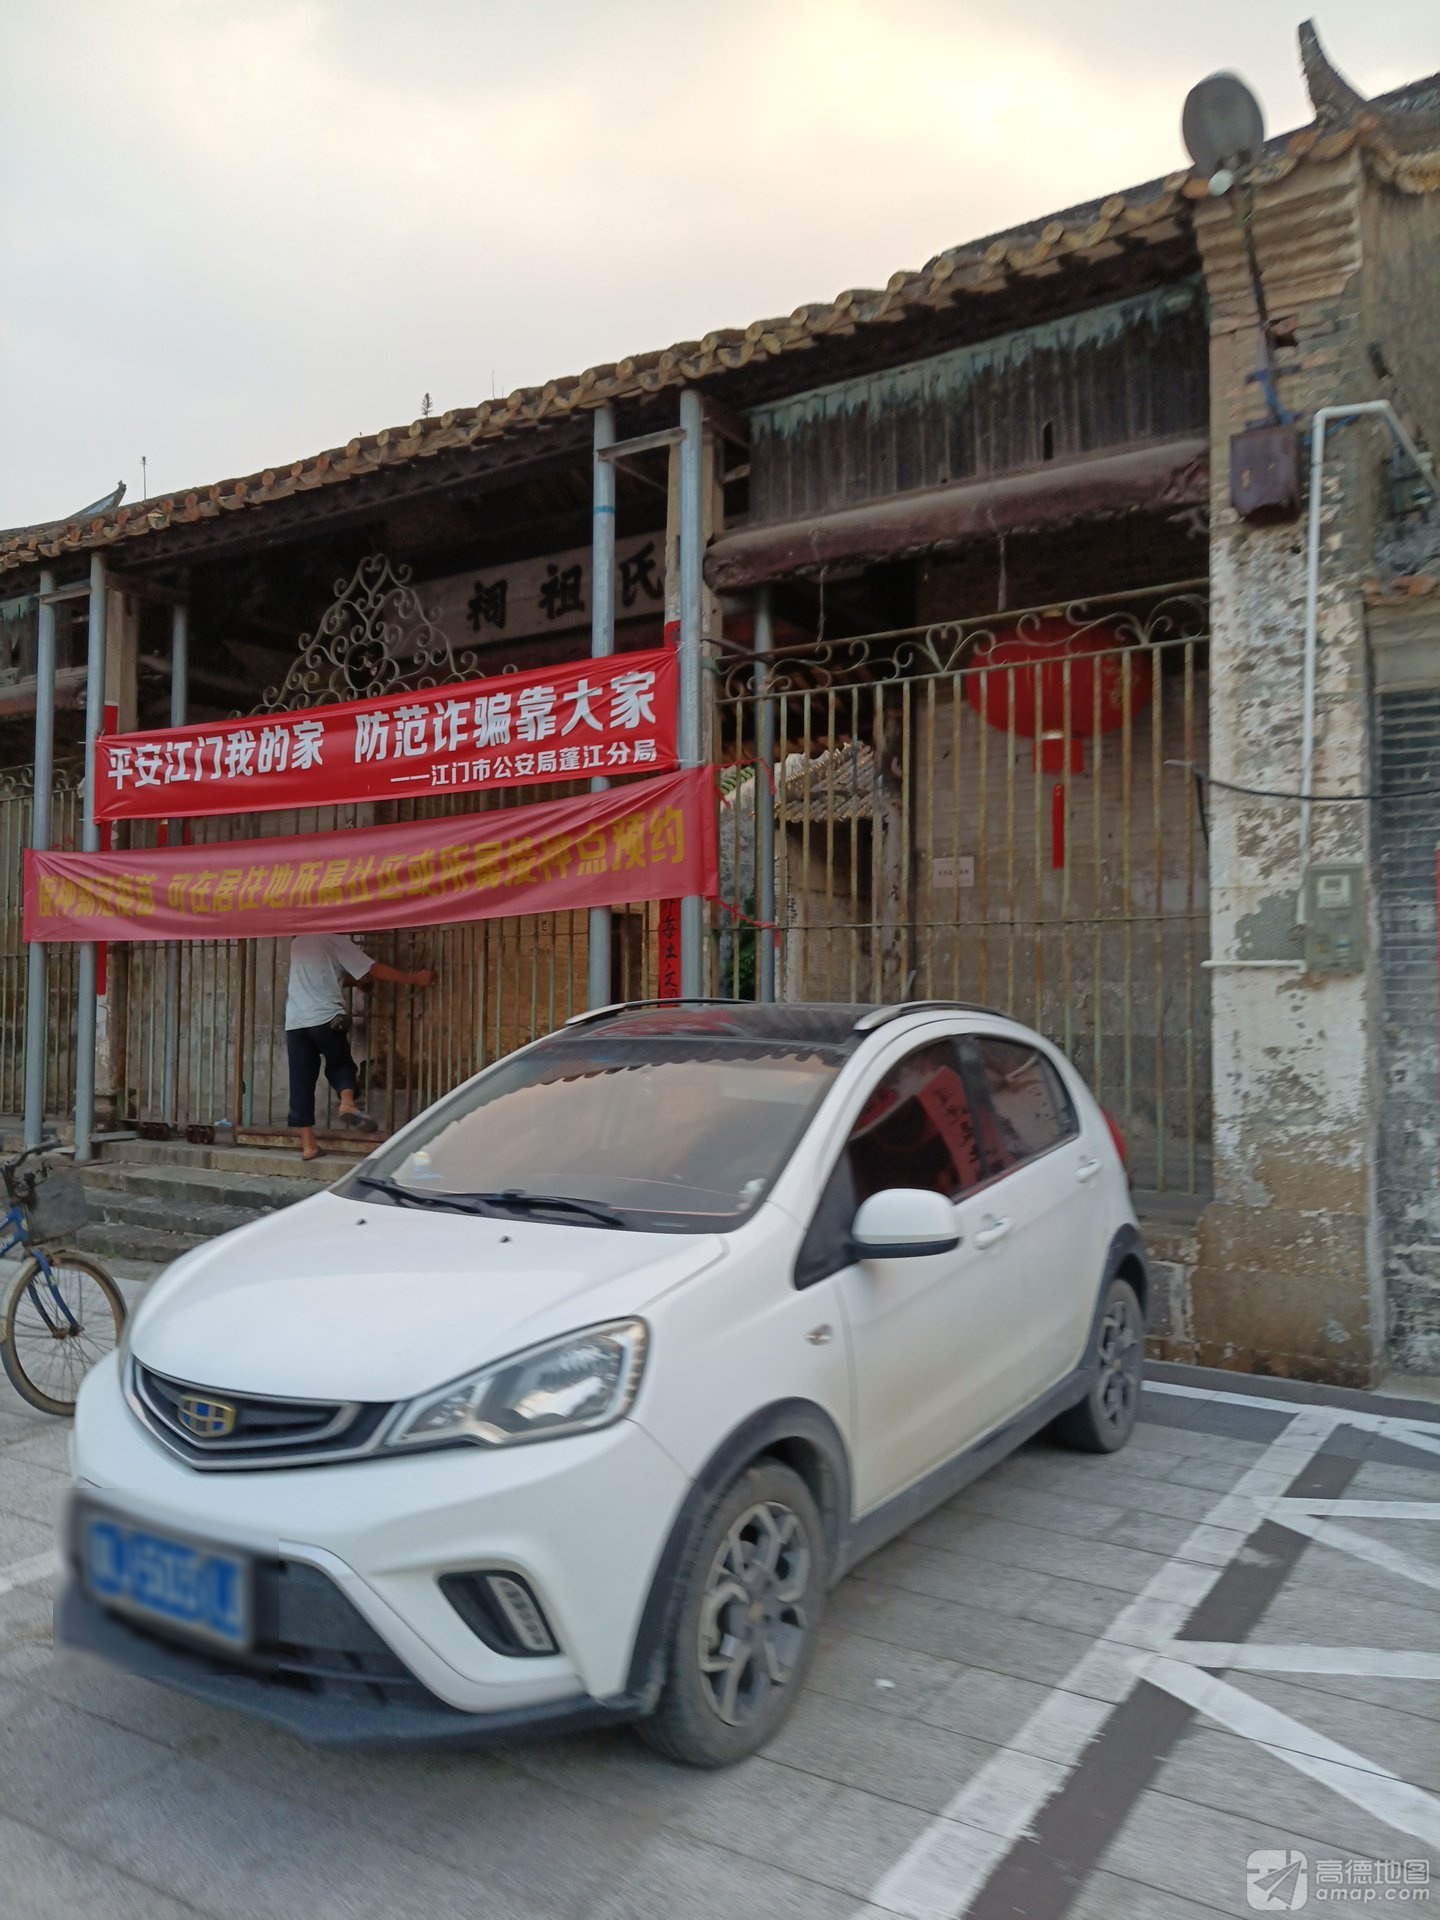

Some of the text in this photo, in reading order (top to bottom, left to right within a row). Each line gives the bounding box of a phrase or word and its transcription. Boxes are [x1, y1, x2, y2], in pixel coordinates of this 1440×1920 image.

[107, 671, 656, 791] 平安江门我的家 防范诈骗靠大家
